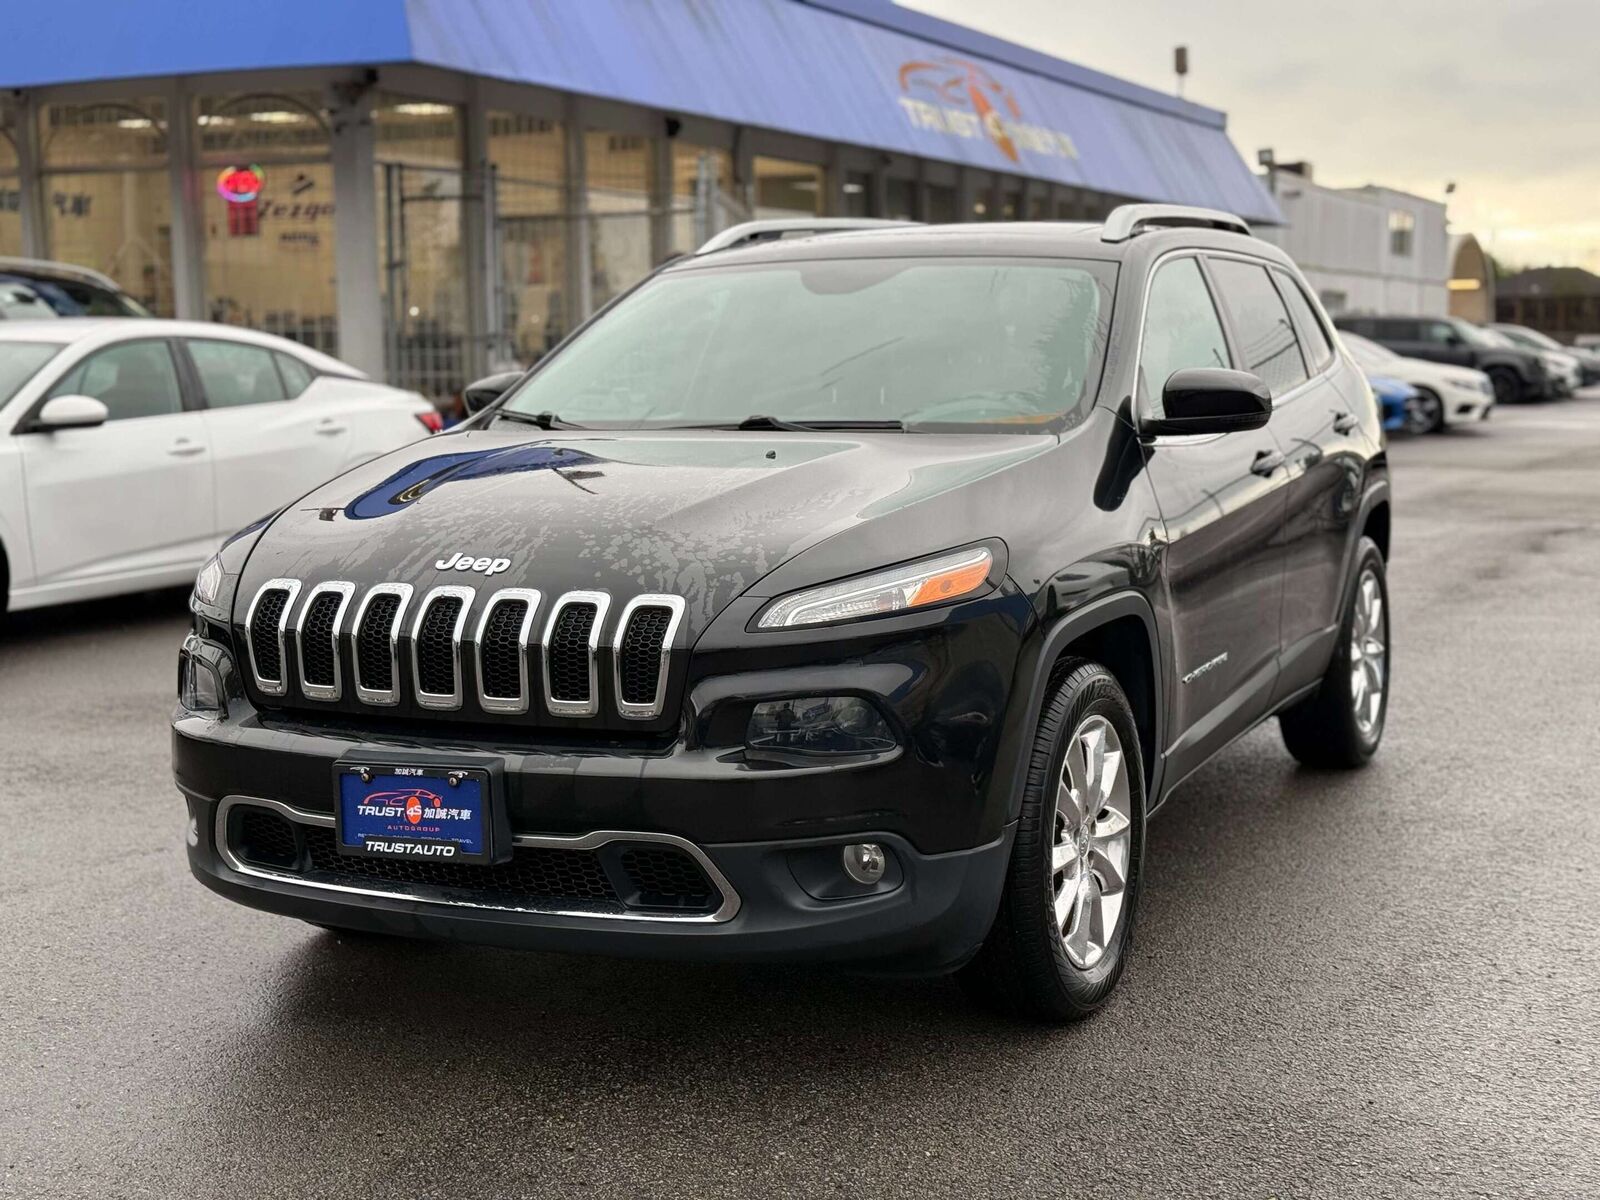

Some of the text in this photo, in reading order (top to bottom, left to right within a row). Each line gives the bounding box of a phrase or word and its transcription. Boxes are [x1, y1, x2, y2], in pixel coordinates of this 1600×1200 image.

[435, 552, 511, 576] Jeep
[357, 805, 473, 821] TRUST 4S 加誠汽車
[365, 841, 455, 857] TRUSTAUTO
